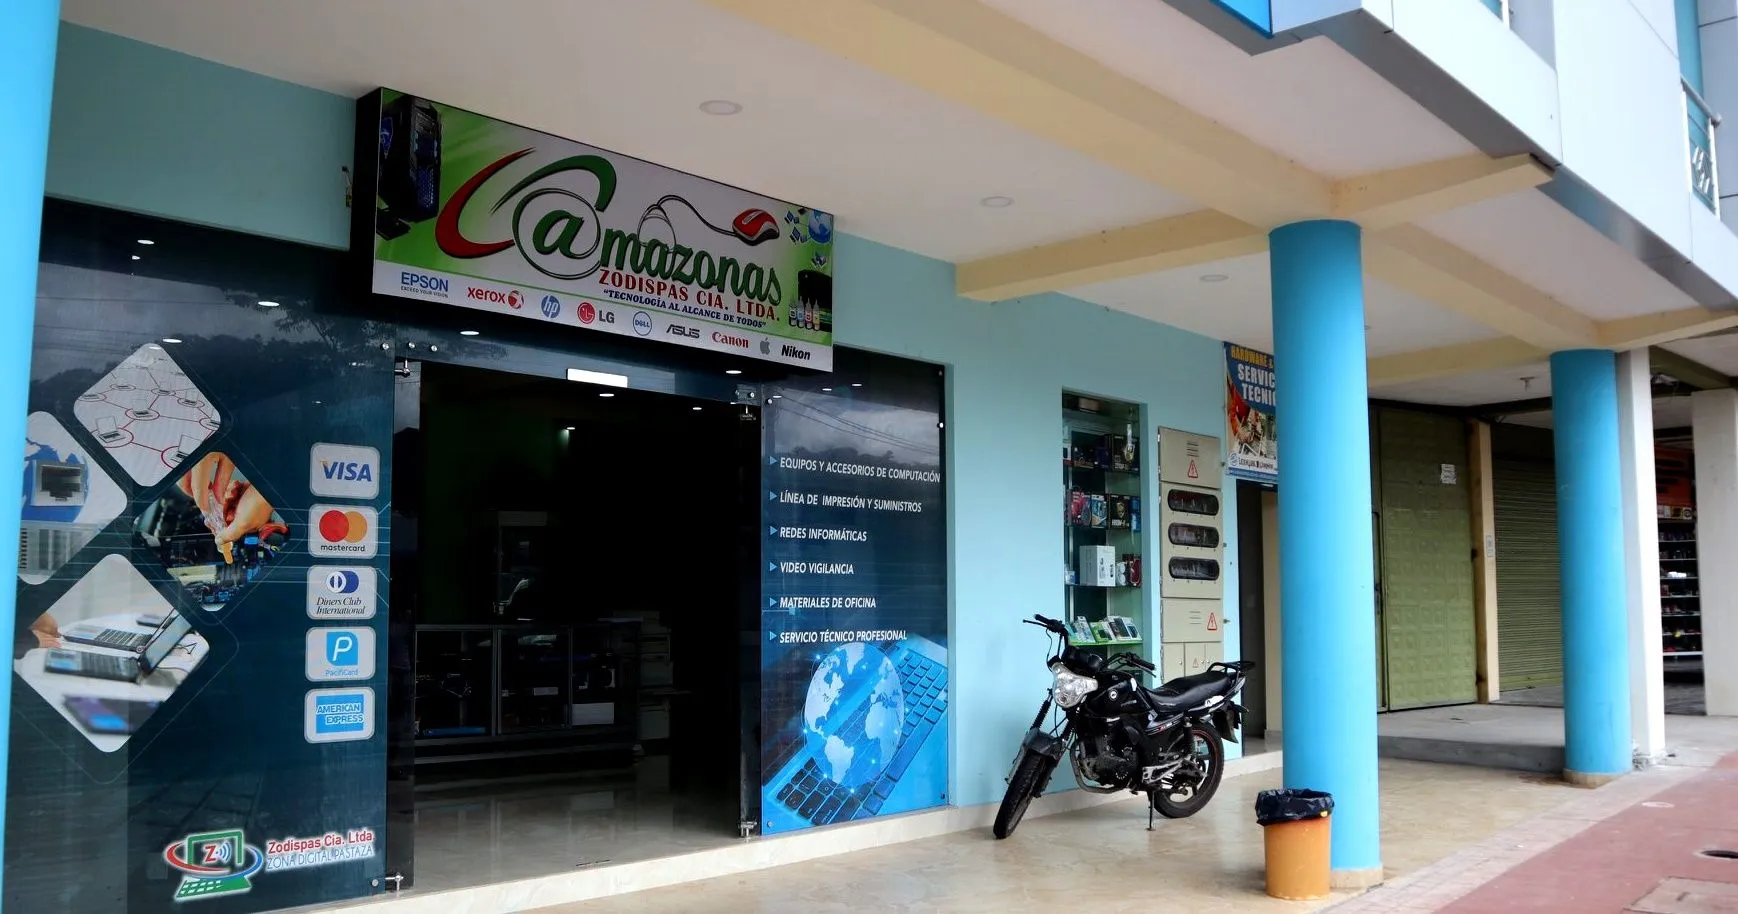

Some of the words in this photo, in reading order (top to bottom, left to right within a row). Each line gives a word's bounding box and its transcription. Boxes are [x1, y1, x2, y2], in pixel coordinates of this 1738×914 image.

[400, 285, 420, 293] EXCEED
[401, 271, 449, 293] EPSON
[467, 286, 506, 305] xerox
[599, 269, 689, 301] ZODISPAS
[696, 290, 729, 310] CIA.
[736, 299, 780, 321] LTDA.
[598, 309, 615, 324] LG
[668, 302, 680, 311] AL
[681, 305, 721, 320] ALCANCE
[723, 313, 735, 323] DE
[634, 319, 651, 329] DELL
[665, 324, 700, 339] ASUS
[711, 331, 749, 349] Canon
[781, 344, 811, 361] Nikon
[320, 461, 372, 482] VISA
[780, 457, 817, 471] EQUIPOS
[818, 461, 825, 472] Y
[826, 462, 875, 477] ACCESORIOS
[876, 467, 887, 478] DE
[888, 468, 941, 483] COMPUTACIÓN
[780, 489, 805, 505] LÍNEA
[807, 494, 818, 505] DE
[822, 495, 866, 509] IMPRESIÓN
[867, 499, 873, 509] Y
[874, 500, 922, 513] SUMINISTROS
[780, 526, 807, 539] REDES
[808, 528, 868, 542] INFORMÁTICAS
[320, 544, 366, 552] mastercard
[780, 562, 807, 573] VIDEO
[808, 562, 855, 574] VIGILANCIA
[316, 597, 342, 606] Diners
[343, 597, 362, 606] Club
[780, 597, 830, 608] MATERIALES
[832, 597, 843, 608] DE
[844, 597, 877, 608] OFICINA
[316, 606, 366, 615] International
[779, 630, 818, 643] SERVICIO
[820, 629, 855, 643] TÉCNICO
[856, 630, 908, 642] PROFESIONAL
[317, 703, 360, 714] AMERICAN
[326, 715, 364, 724] EXPRESS
[268, 838, 322, 854] Zodispas
[324, 834, 345, 847] Cia.
[266, 854, 296, 869] ZONA
[297, 849, 332, 865] DIGITAL
[334, 844, 374, 858] PASTAZA
